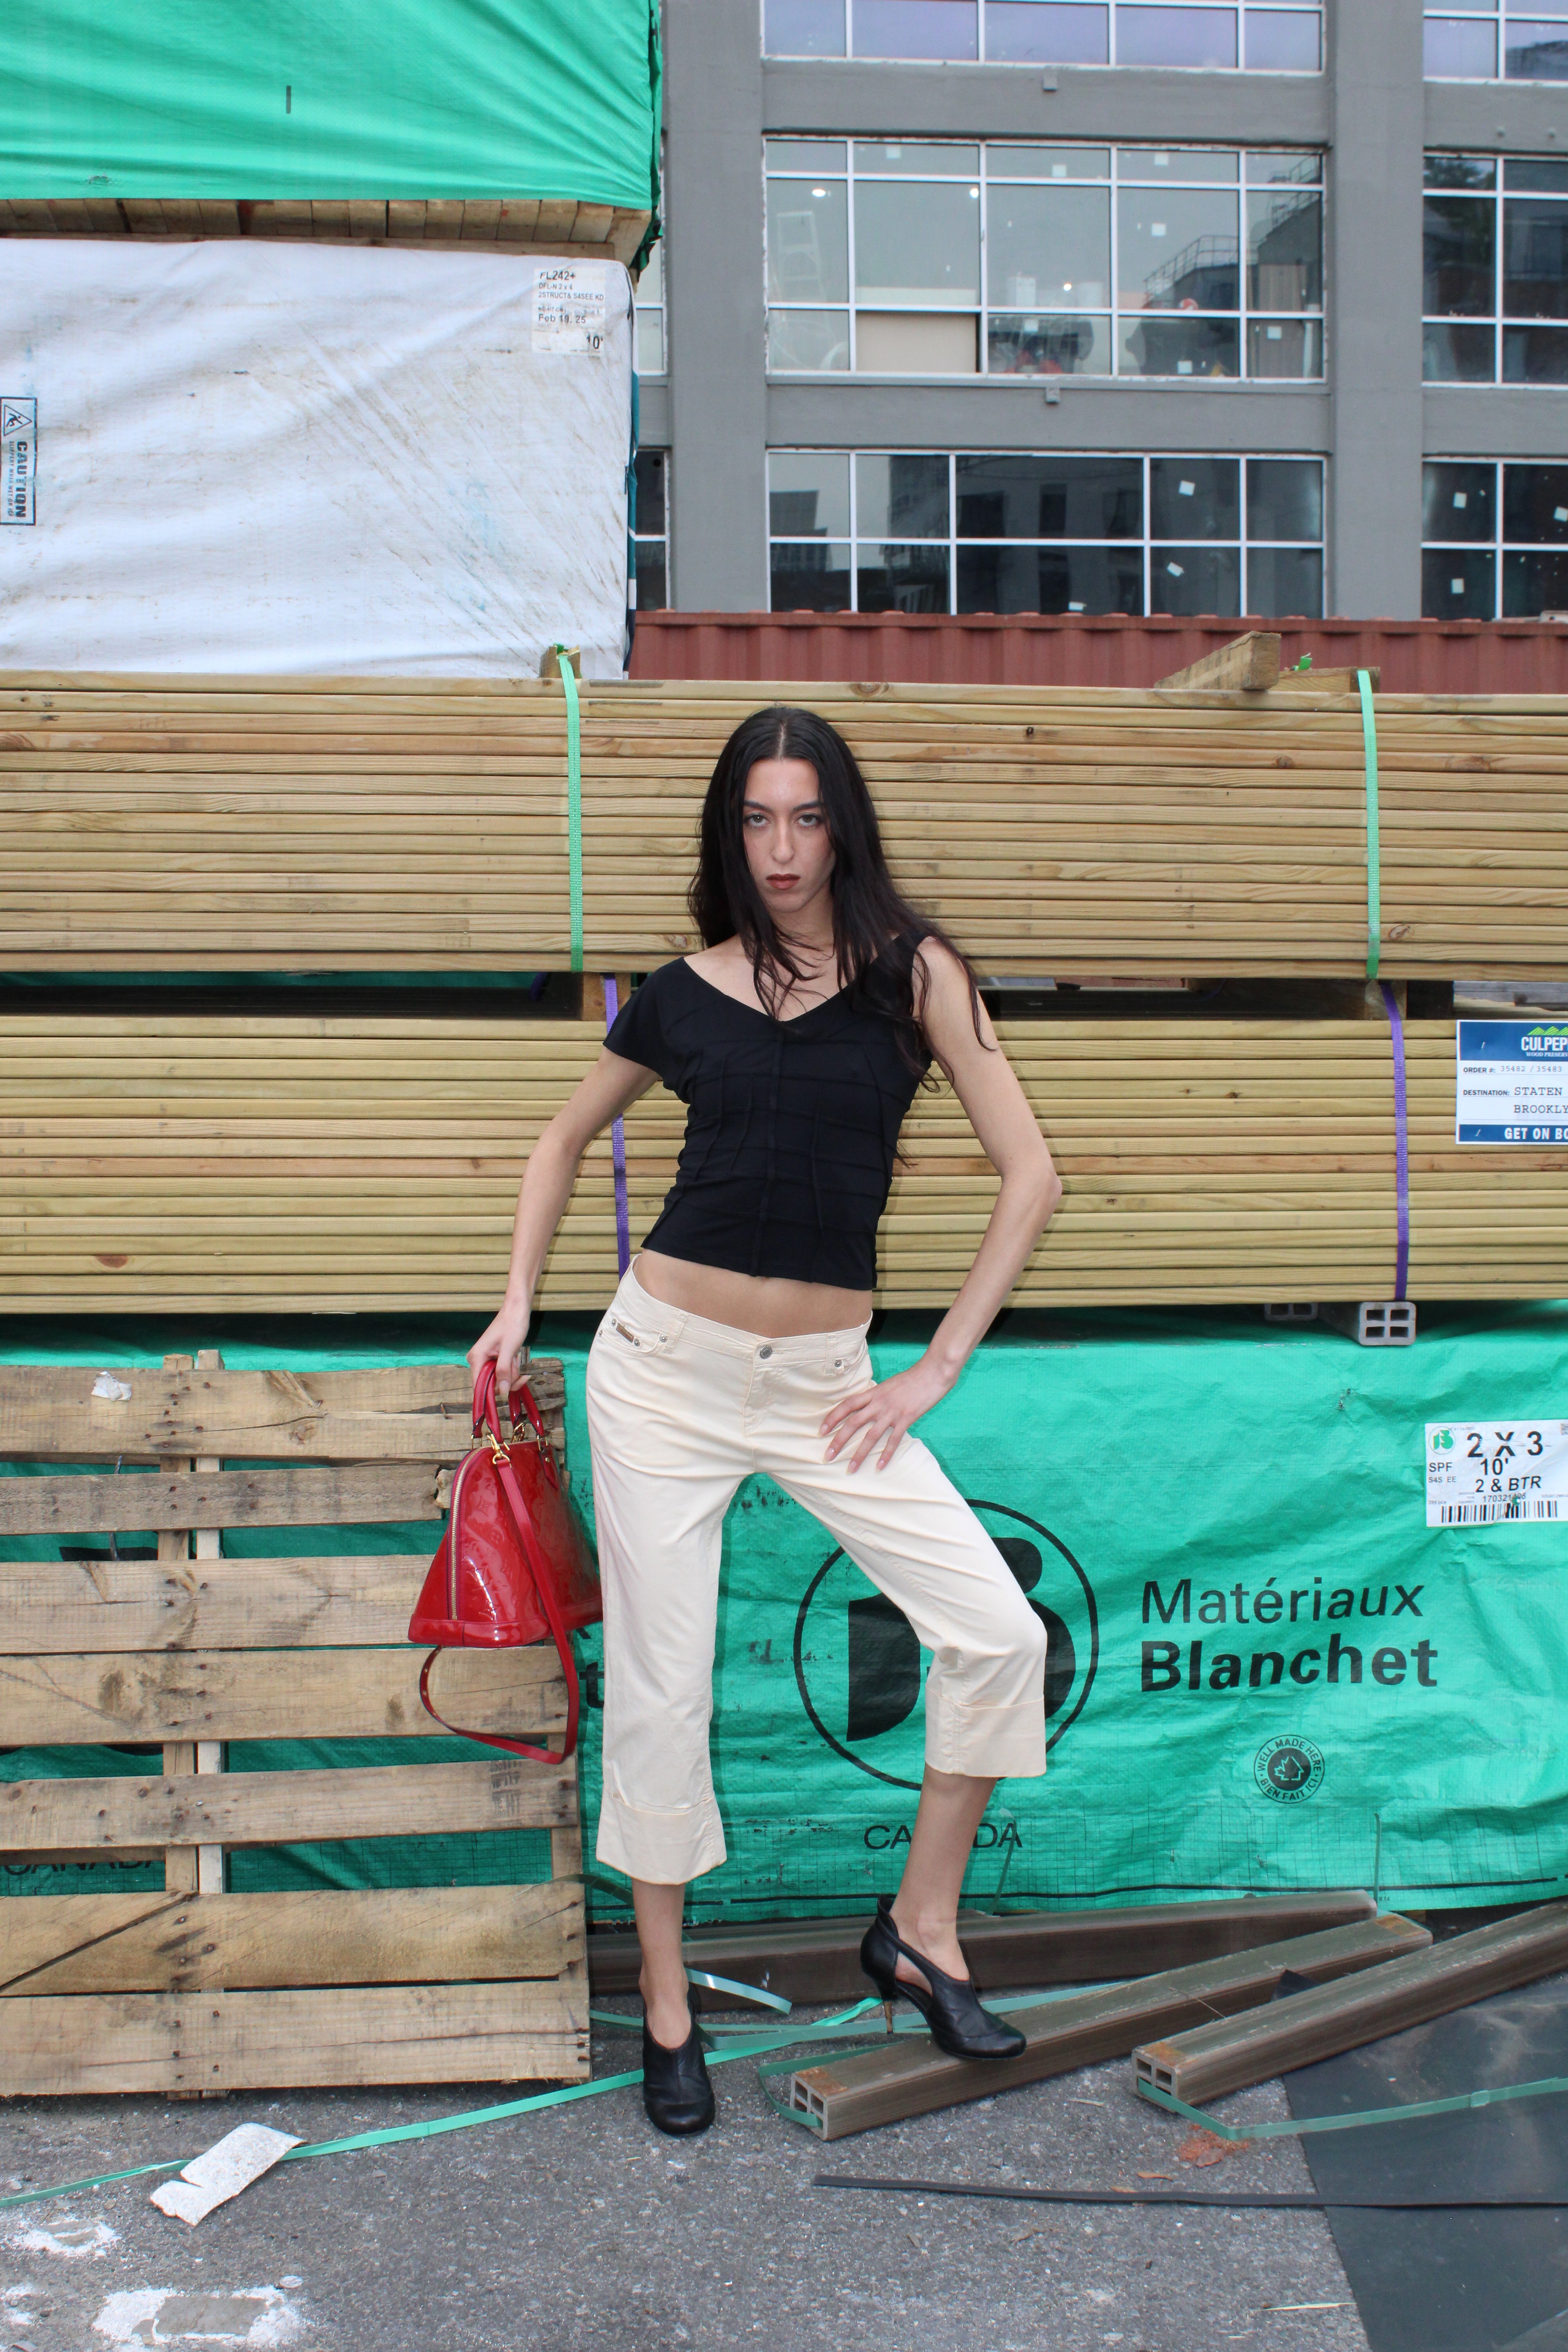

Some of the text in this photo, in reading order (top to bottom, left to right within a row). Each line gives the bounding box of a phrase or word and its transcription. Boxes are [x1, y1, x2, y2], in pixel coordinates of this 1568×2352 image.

[540, 270, 576, 280] FL242+
[539, 313, 556, 322] Feb
[575, 315, 586, 324] 25
[15, 441, 28, 518] CAUTION
[1521, 1036, 1568, 1051] CULPEP
[1514, 1087, 1562, 1096] STATEN
[1513, 1105, 1568, 1114] BROOKLY
[1504, 1127, 1528, 1140] GET
[1532, 1128, 1550, 1140] ON
[1467, 1433, 1483, 1457] 2
[1527, 1431, 1544, 1456] 3
[1429, 1462, 1452, 1472] SPF
[1480, 1458, 1509, 1475] 10'
[1475, 1476, 1541, 1492] 2 & BTR
[1142, 1577, 1425, 1624] Matériaux
[1141, 1633, 1438, 1693] Blanchet
[1258, 1738, 1321, 1771] WELL MADE HERE
[1260, 1777, 1318, 1800] BIEN FAIT ICI
[864, 1823, 1023, 1849] CADA
